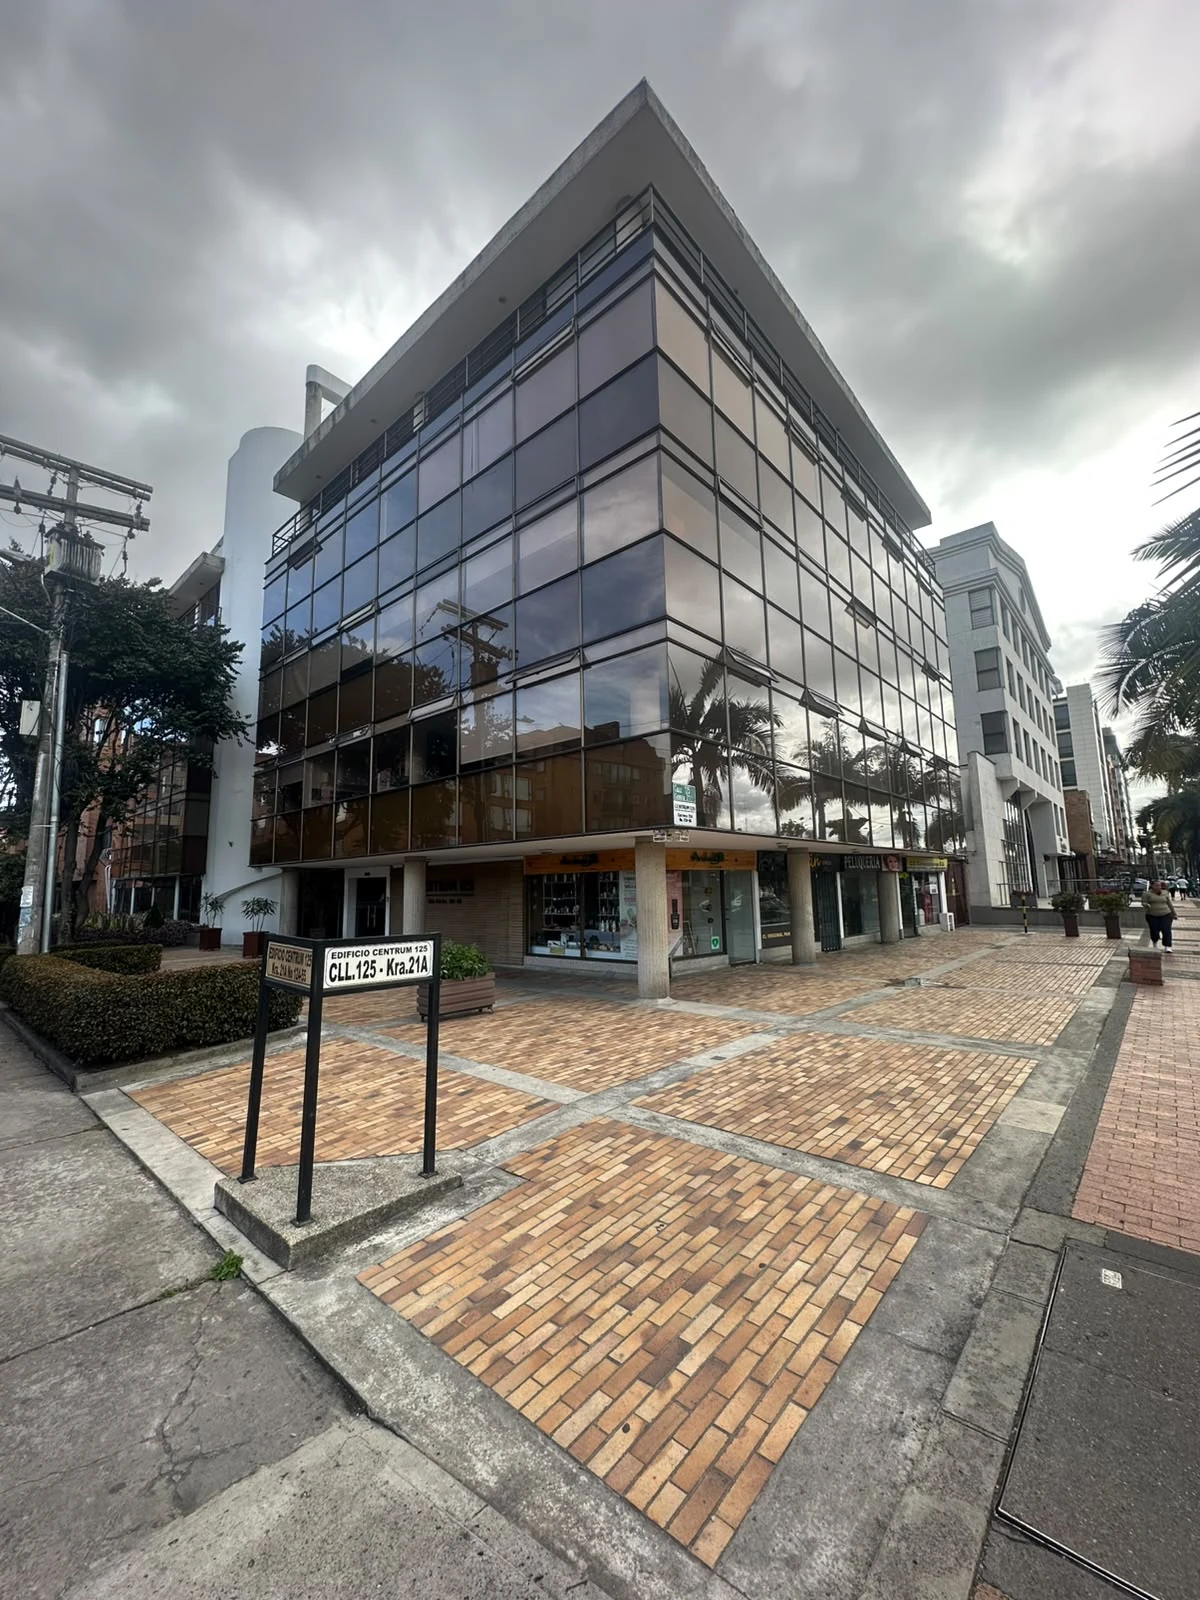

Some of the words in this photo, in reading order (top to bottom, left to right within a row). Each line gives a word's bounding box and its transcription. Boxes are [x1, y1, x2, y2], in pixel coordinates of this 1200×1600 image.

[331, 949, 370, 960] EDIFICIO
[372, 946, 412, 956] CENTRUM
[414, 945, 428, 953] 125
[329, 959, 376, 983] CLL.125
[386, 955, 428, 977] Kra.21A
